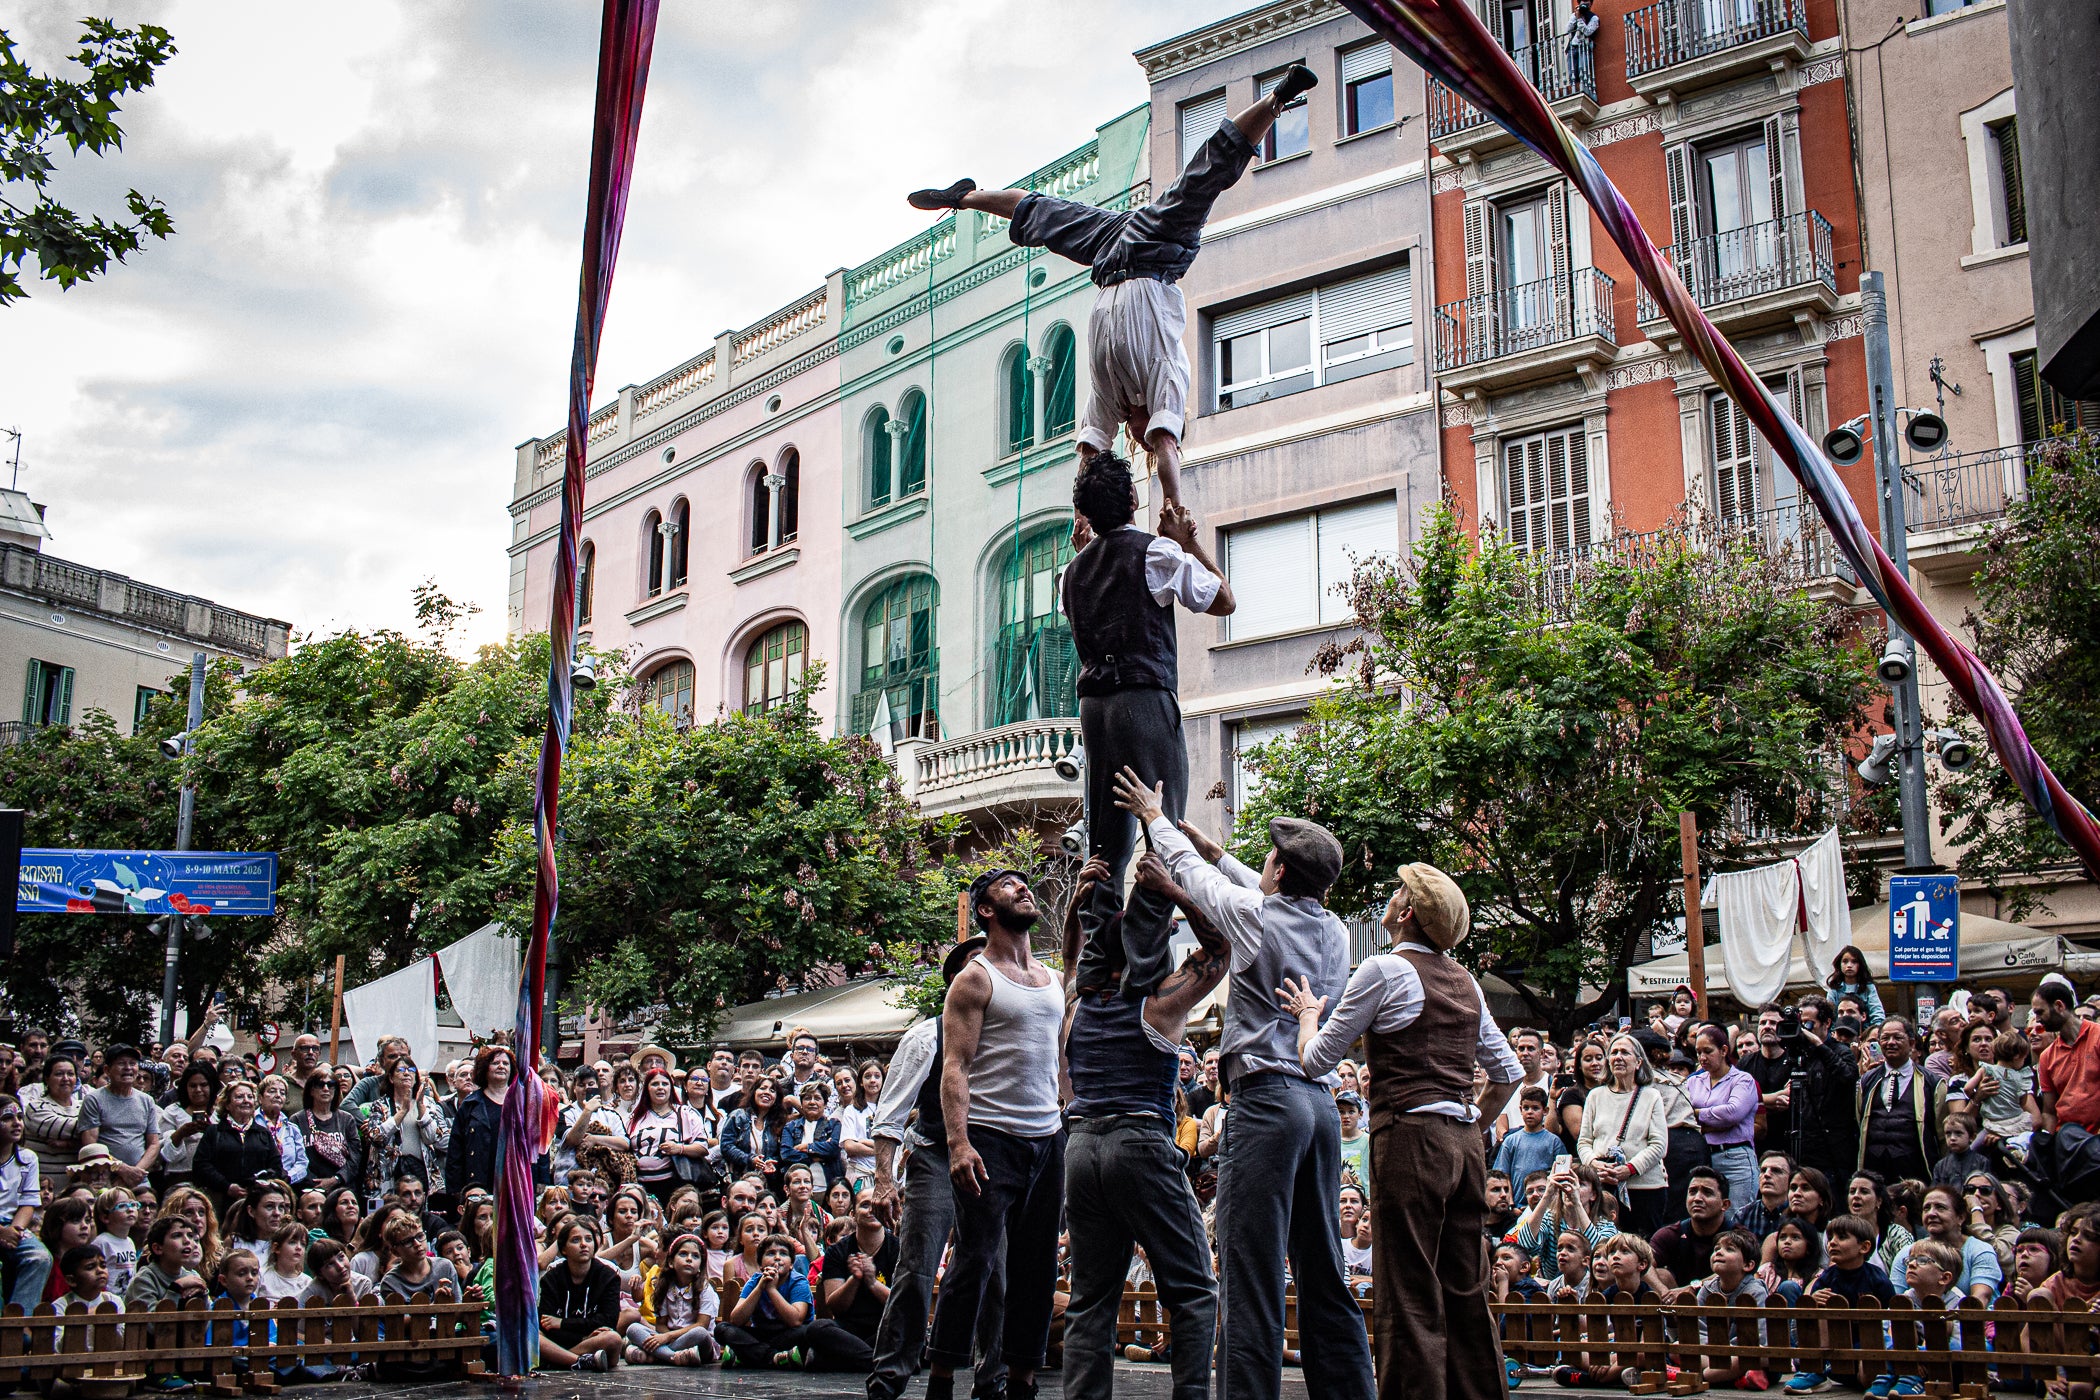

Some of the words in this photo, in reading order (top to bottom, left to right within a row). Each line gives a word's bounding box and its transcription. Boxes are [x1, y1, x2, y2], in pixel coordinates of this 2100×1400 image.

[213, 864, 240, 875] MAIG
[242, 865, 262, 875] 2026
[2021, 956, 2048, 965] central
[1649, 977, 1685, 985] ESTRELLA
